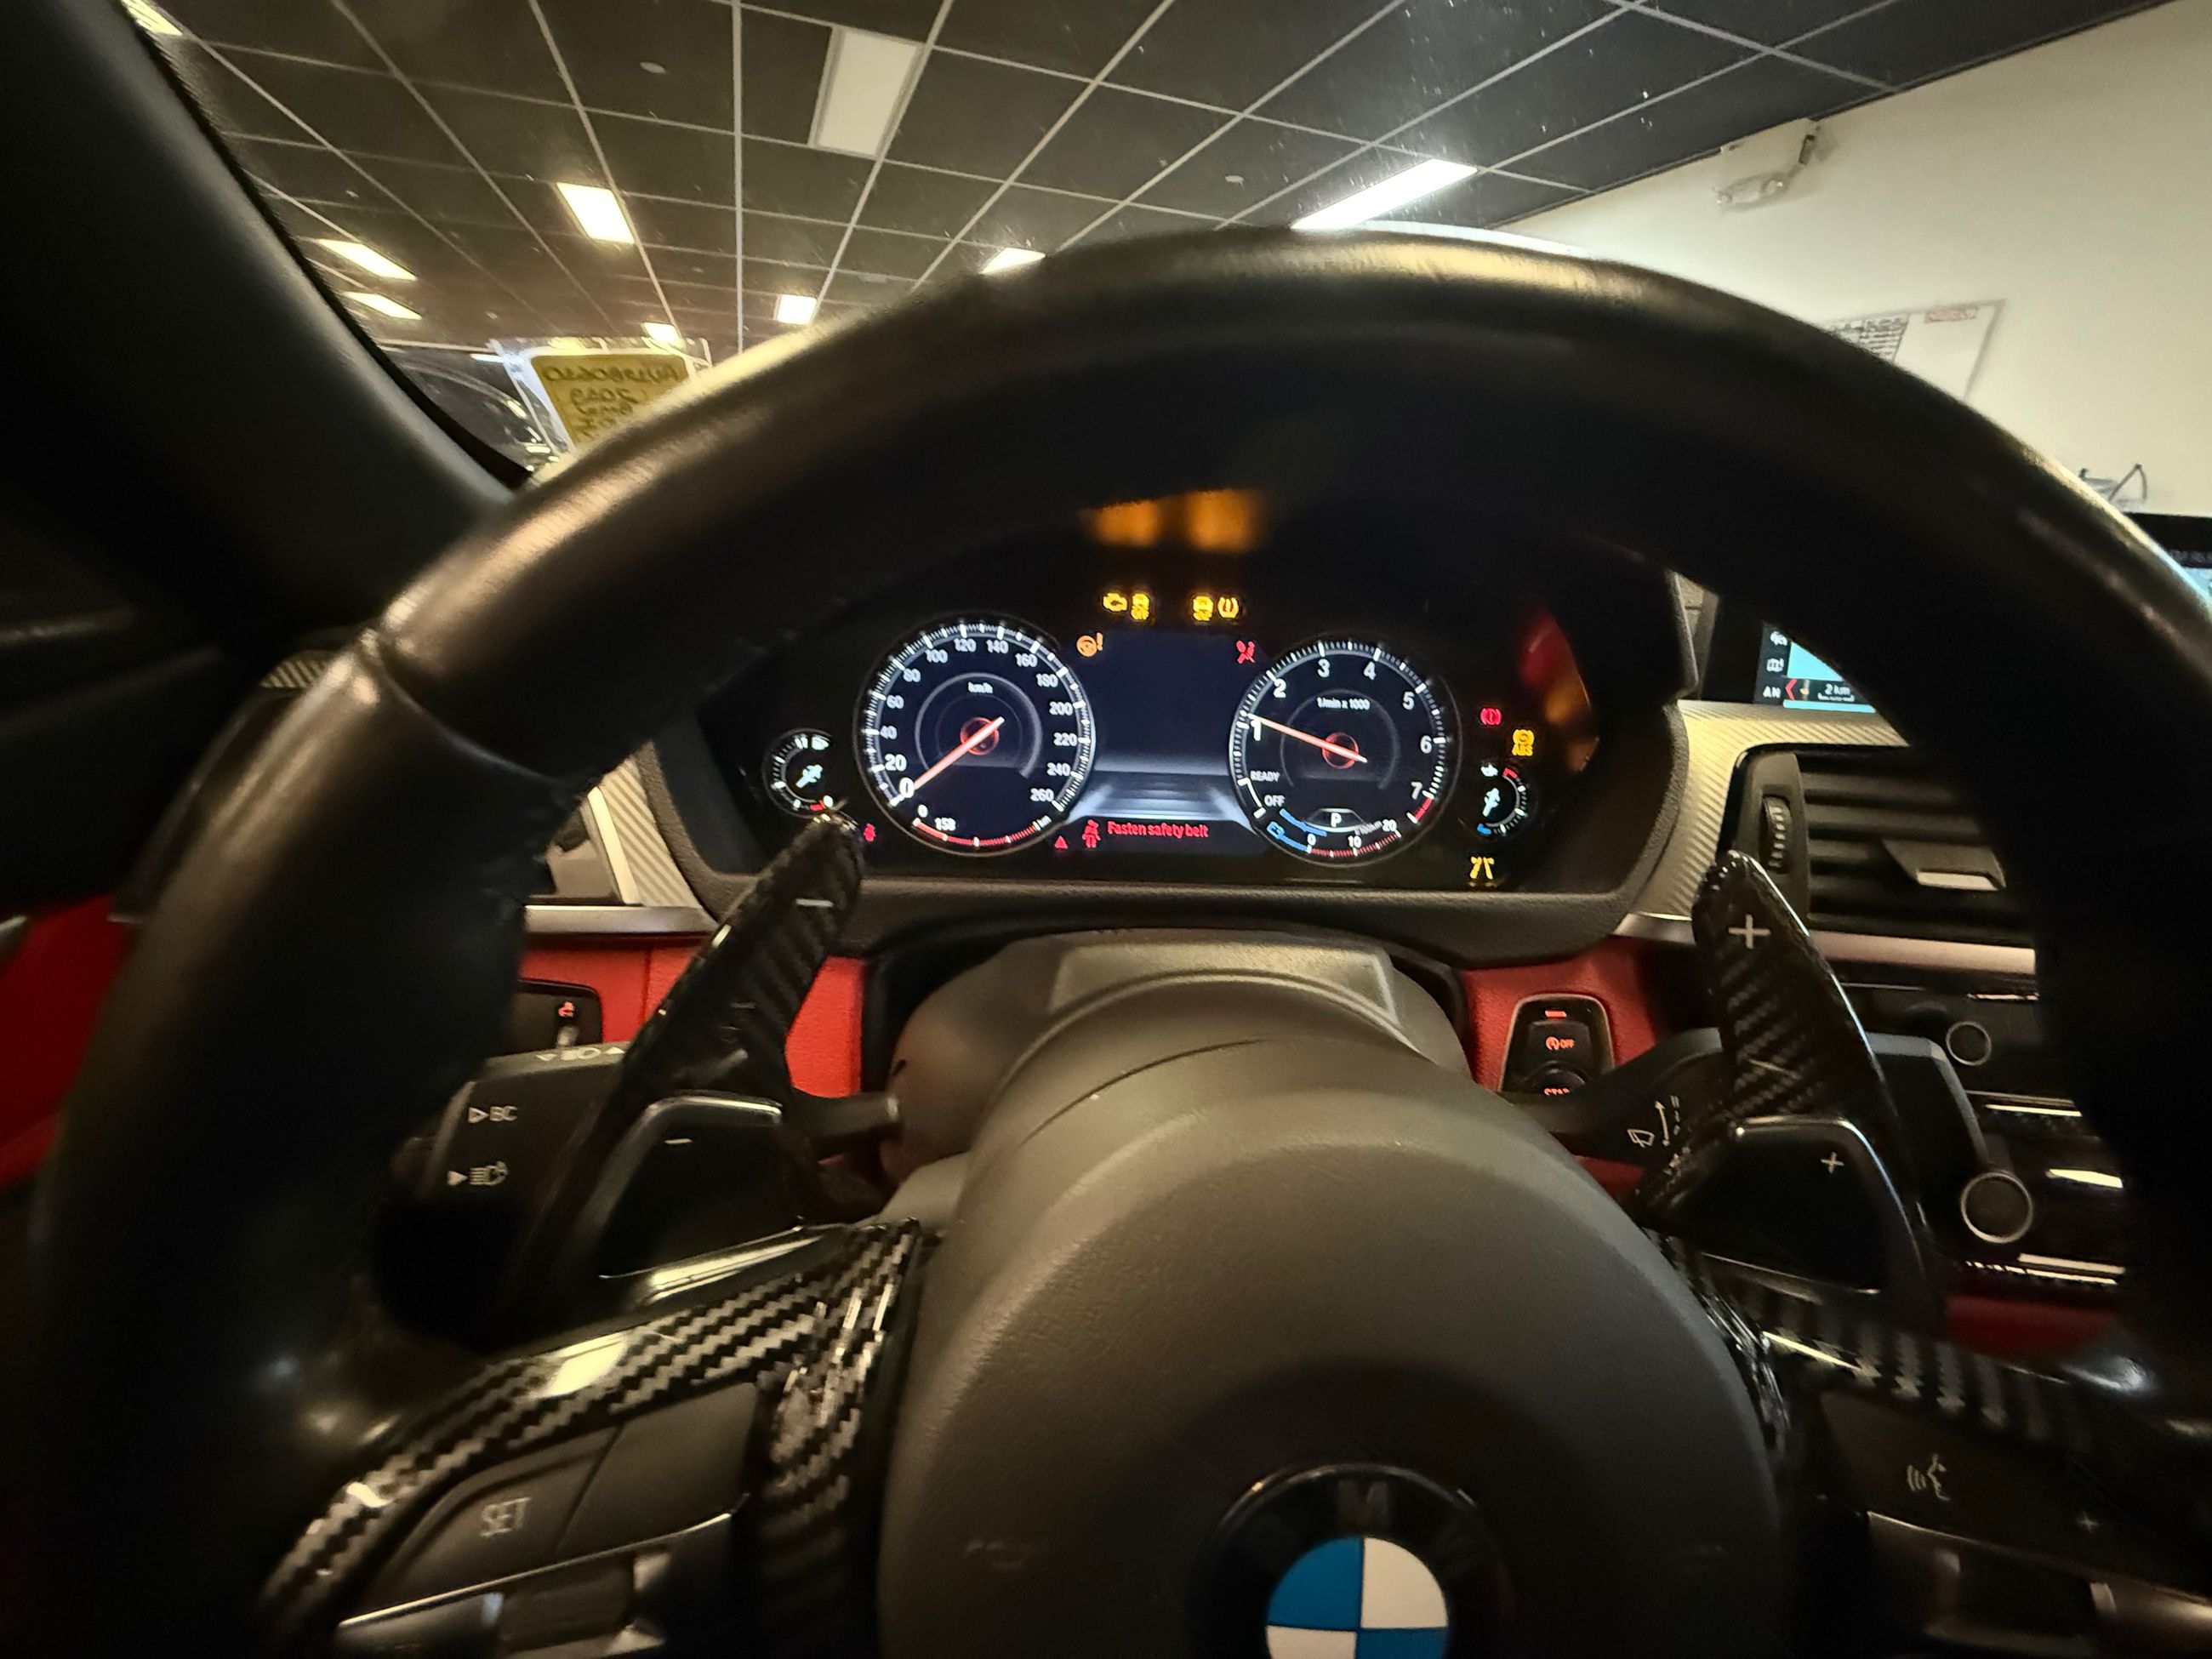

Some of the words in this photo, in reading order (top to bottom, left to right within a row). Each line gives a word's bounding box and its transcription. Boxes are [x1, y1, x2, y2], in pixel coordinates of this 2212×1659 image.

[954, 638, 977, 653] 120
[986, 639, 1009, 654] 140
[925, 648, 949, 664] 100
[1015, 653, 1038, 668] 160
[903, 668, 921, 683] 80
[1317, 658, 1330, 678] 3
[1363, 661, 1377, 681] 4
[1035, 673, 1059, 688] 180
[1273, 678, 1286, 698] 2
[1824, 683, 1833, 695] 2
[1833, 684, 1851, 696] km
[887, 694, 904, 710] 60
[1049, 701, 1074, 716] 200
[1348, 698, 1371, 710] 1000
[1402, 691, 1415, 711] 5
[880, 725, 898, 740] 40
[1251, 717, 1262, 742] 1
[1053, 732, 1078, 747] 220
[1420, 735, 1433, 754] 6
[885, 753, 907, 772] 20
[1046, 761, 1071, 777] 240
[1250, 769, 1280, 783] READY
[899, 777, 915, 799] 0
[1029, 787, 1054, 802] 260
[1411, 781, 1423, 800] 7
[1263, 794, 1286, 807] OFF
[917, 804, 928, 818] 0
[1331, 812, 1343, 828] P
[1382, 818, 1398, 832] 20
[1107, 820, 1147, 836] Fasten
[1147, 822, 1184, 840] safety
[1184, 823, 1209, 838] belt
[1306, 833, 1316, 847] 0
[1348, 835, 1362, 848] 10
[489, 1106, 517, 1121] BC
[480, 1497, 531, 1537] SET
